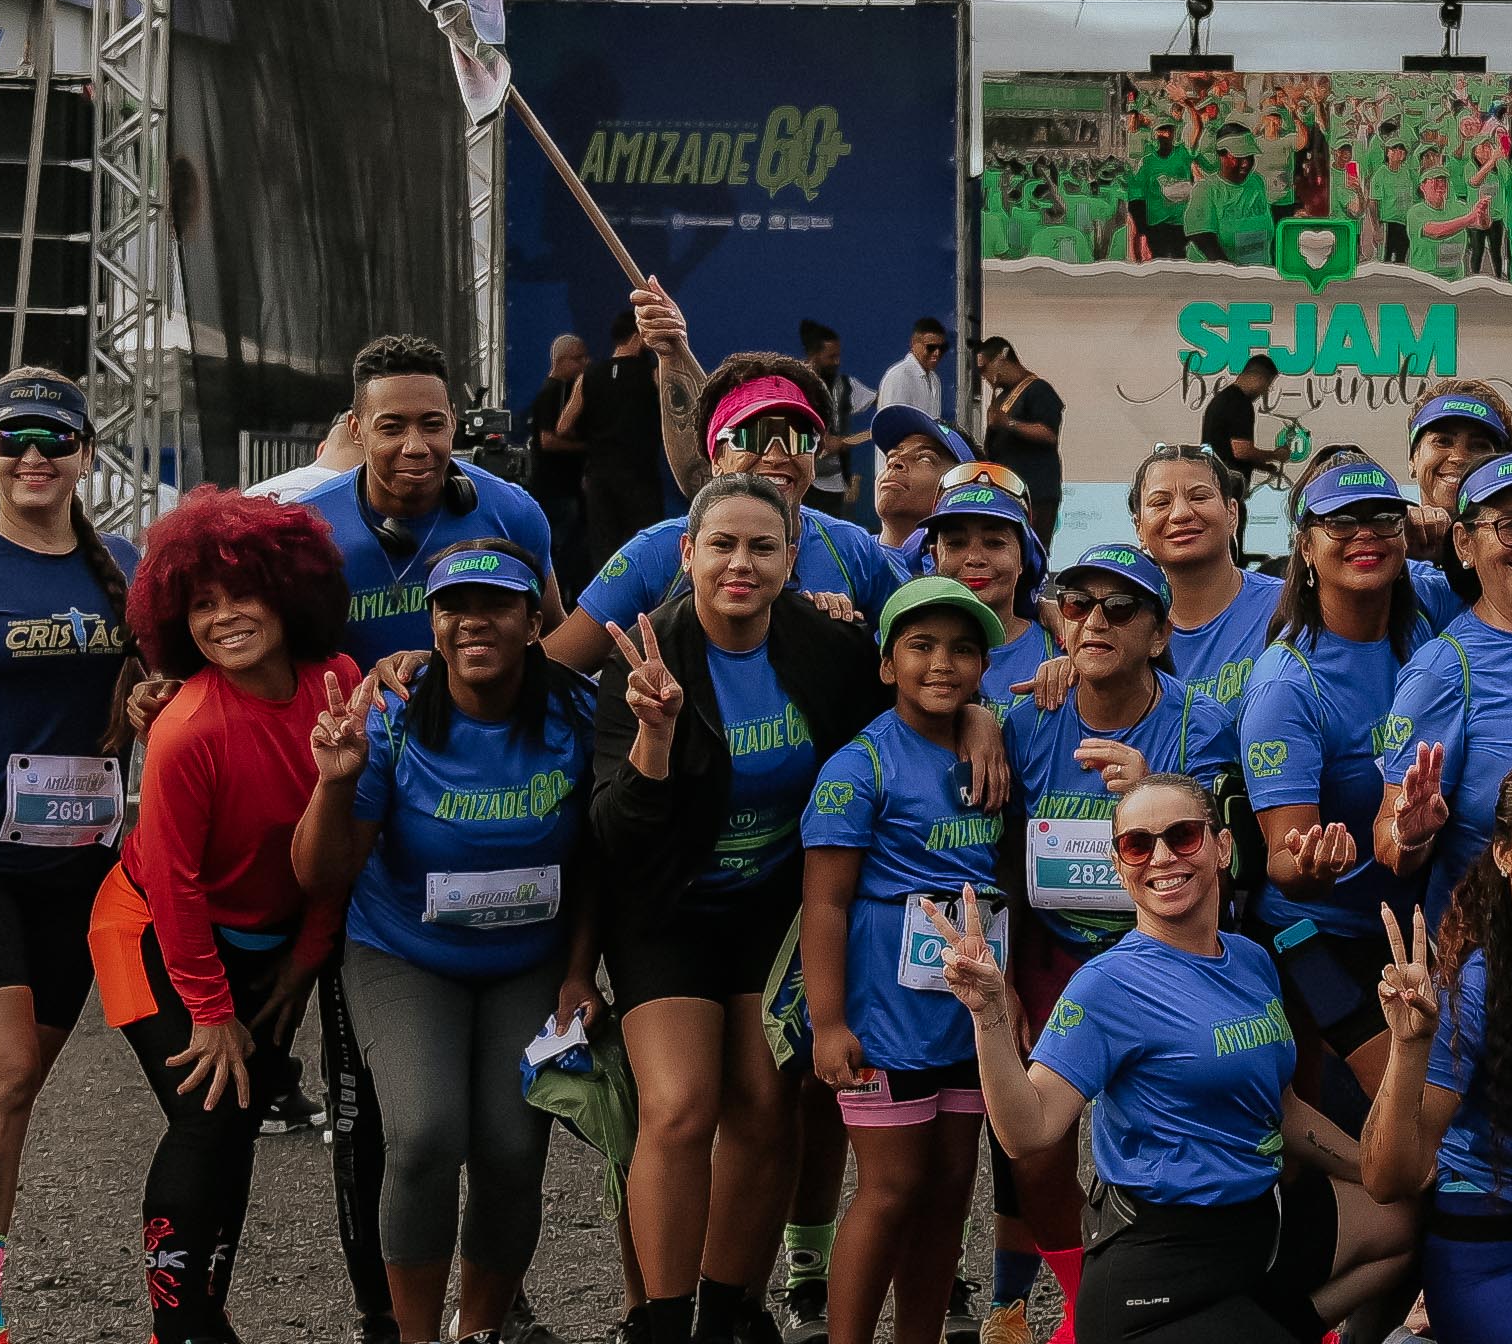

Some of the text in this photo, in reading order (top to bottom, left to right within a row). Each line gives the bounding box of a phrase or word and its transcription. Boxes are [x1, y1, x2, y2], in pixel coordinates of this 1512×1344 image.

[580, 131, 758, 184] AMIZADE
[1178, 301, 1458, 376] SEJAM
[347, 586, 428, 623] AMIZAD
[46, 801, 94, 821] 2691
[434, 789, 529, 820] AMIZADE
